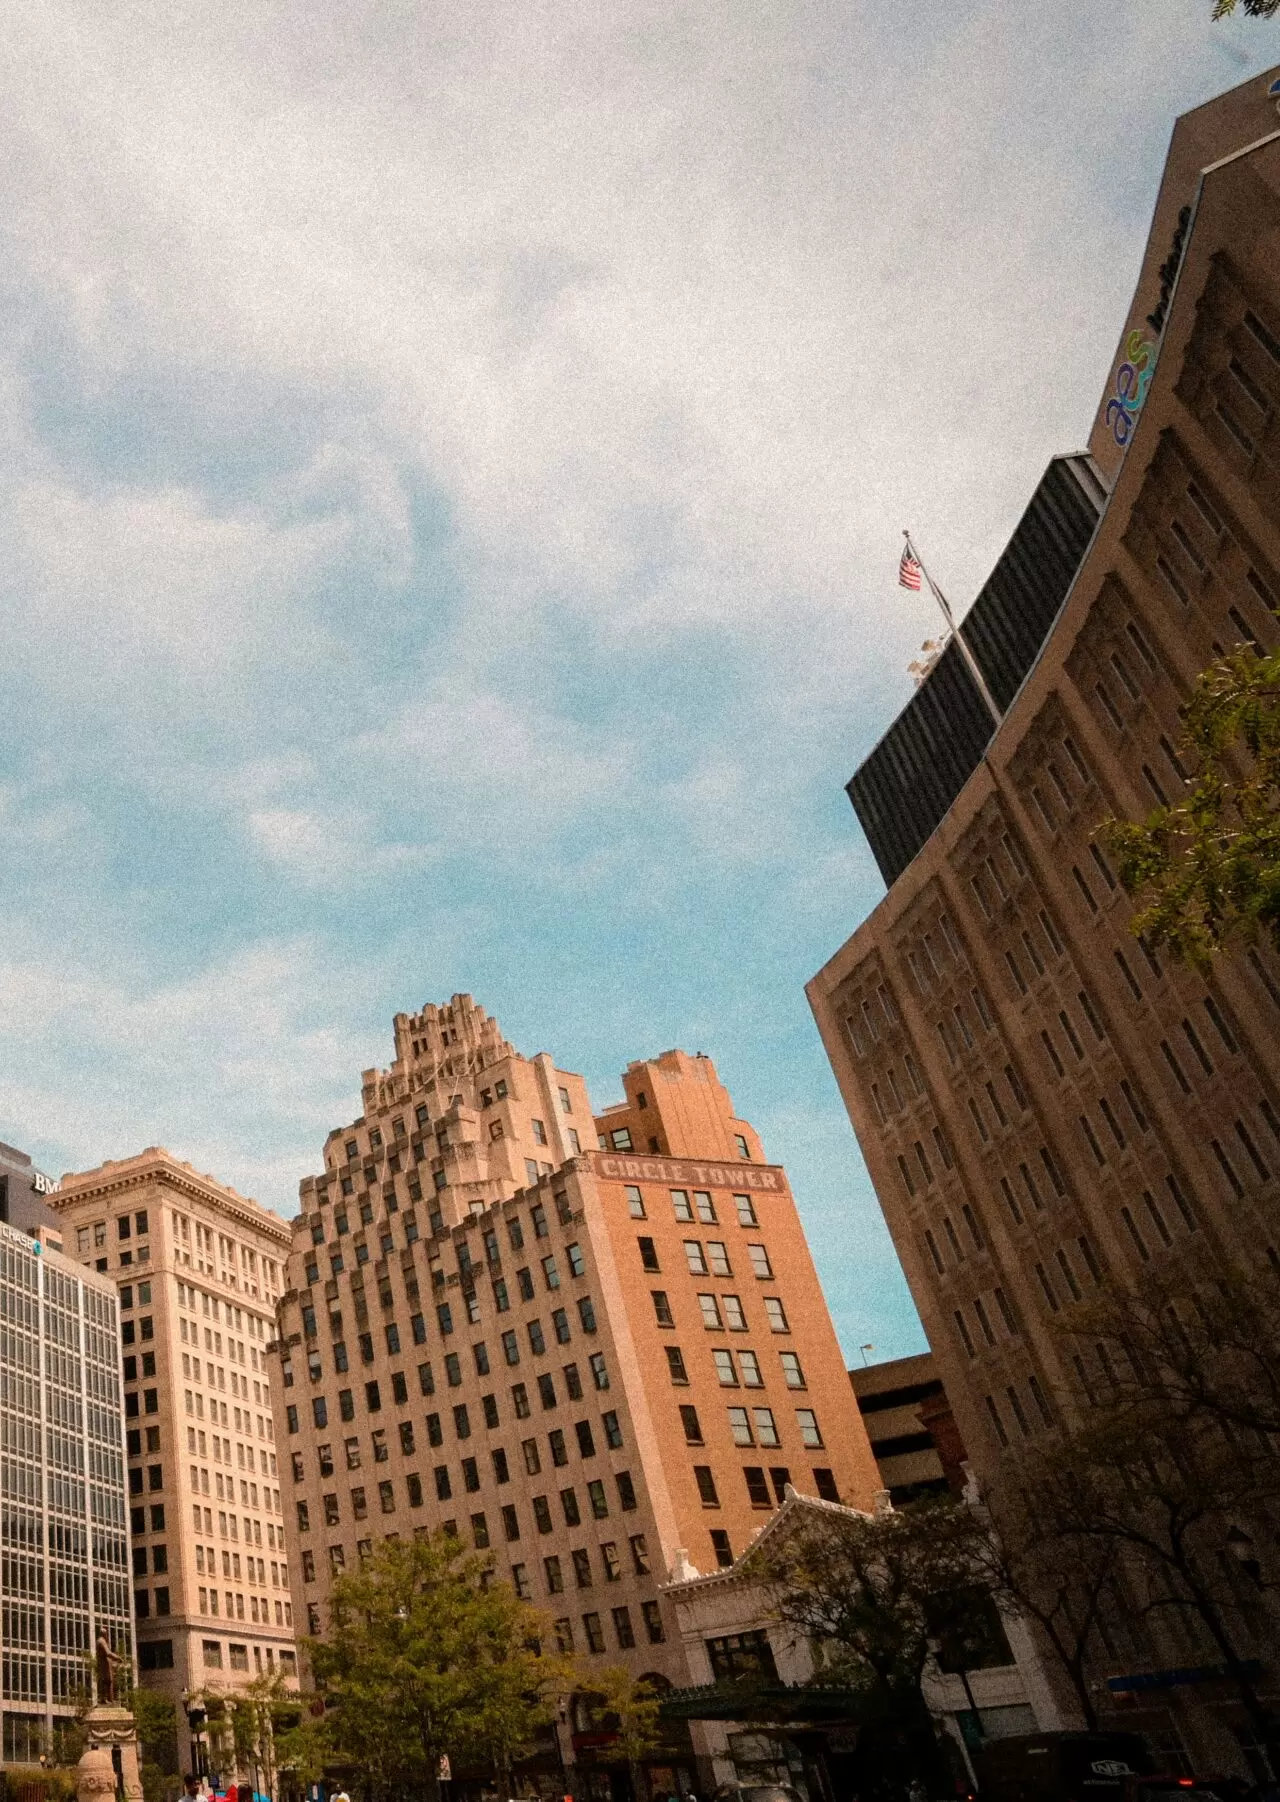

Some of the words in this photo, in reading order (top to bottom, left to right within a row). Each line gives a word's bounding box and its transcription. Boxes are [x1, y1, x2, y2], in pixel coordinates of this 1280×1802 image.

[1105, 328, 1157, 447] aes
[34, 1172, 61, 1194] BM
[600, 1159, 688, 1182] CIRCLE
[692, 1166, 778, 1189] TOWER
[1, 1225, 33, 1250] CHASE
